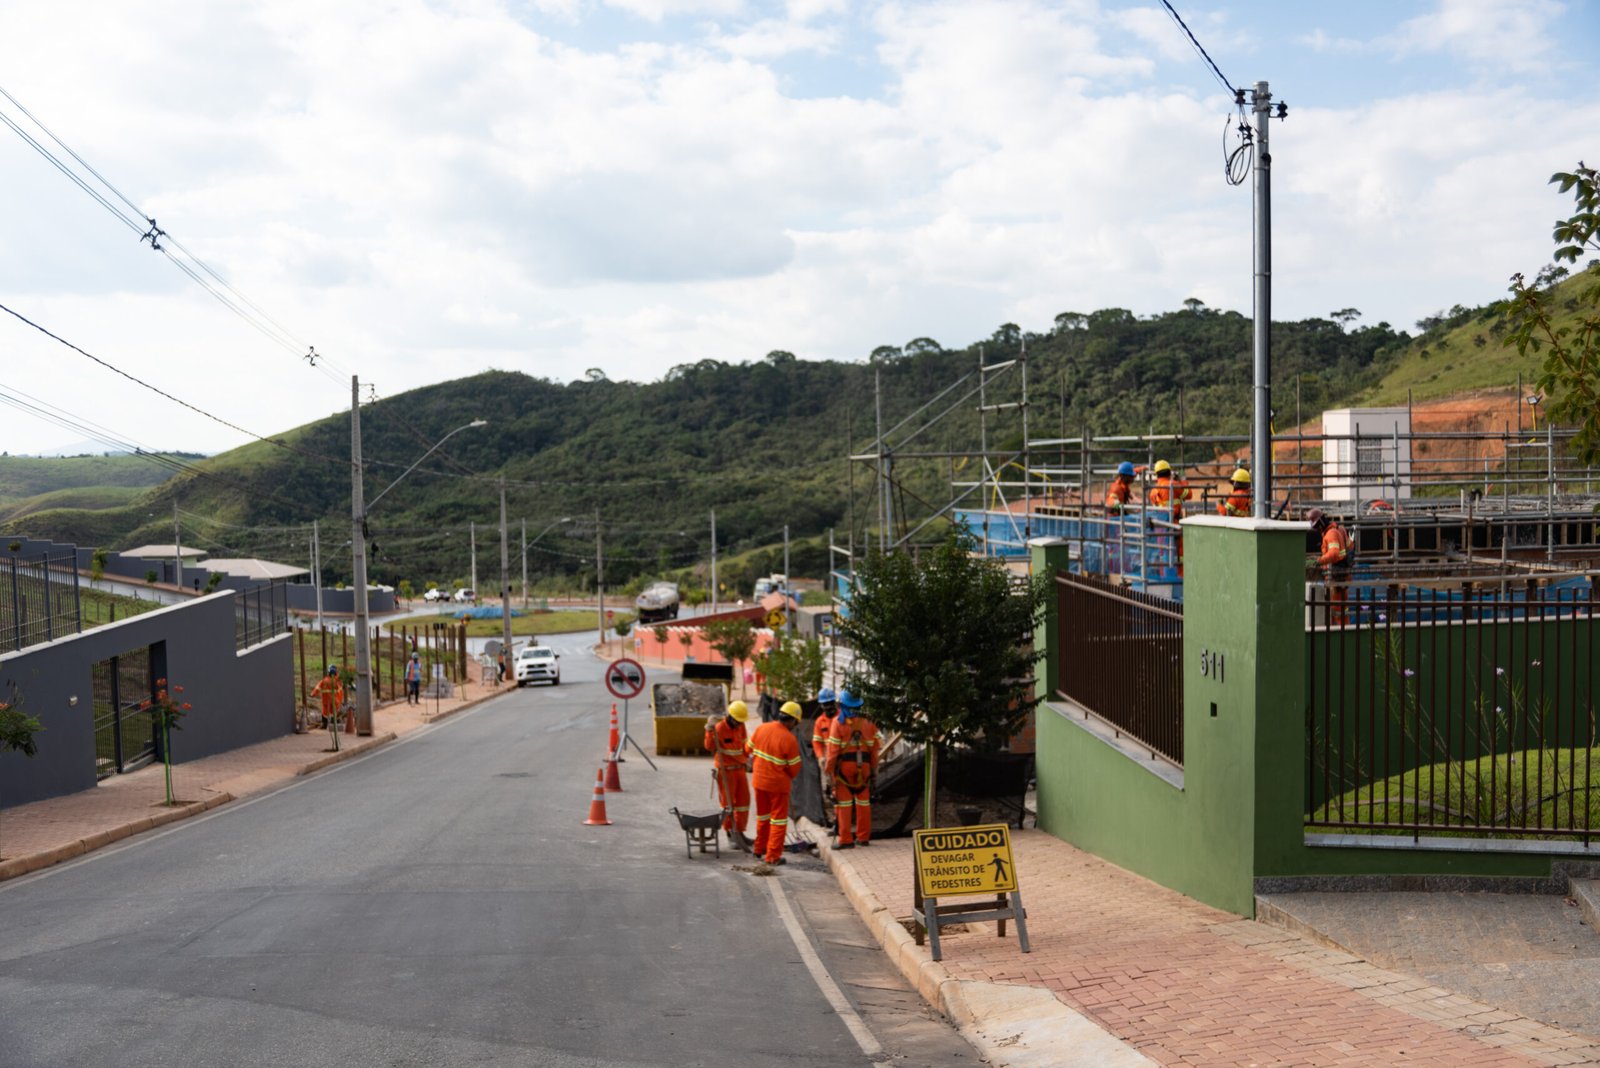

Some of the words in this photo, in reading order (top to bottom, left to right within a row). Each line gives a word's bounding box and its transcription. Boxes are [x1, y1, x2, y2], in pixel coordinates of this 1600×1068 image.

[1200, 648, 1225, 684] 511
[924, 832, 1001, 849] CUIDADO
[930, 852, 975, 863] DEVAGAR
[973, 864, 985, 873] DE
[931, 878, 982, 889] PEDESTRES
